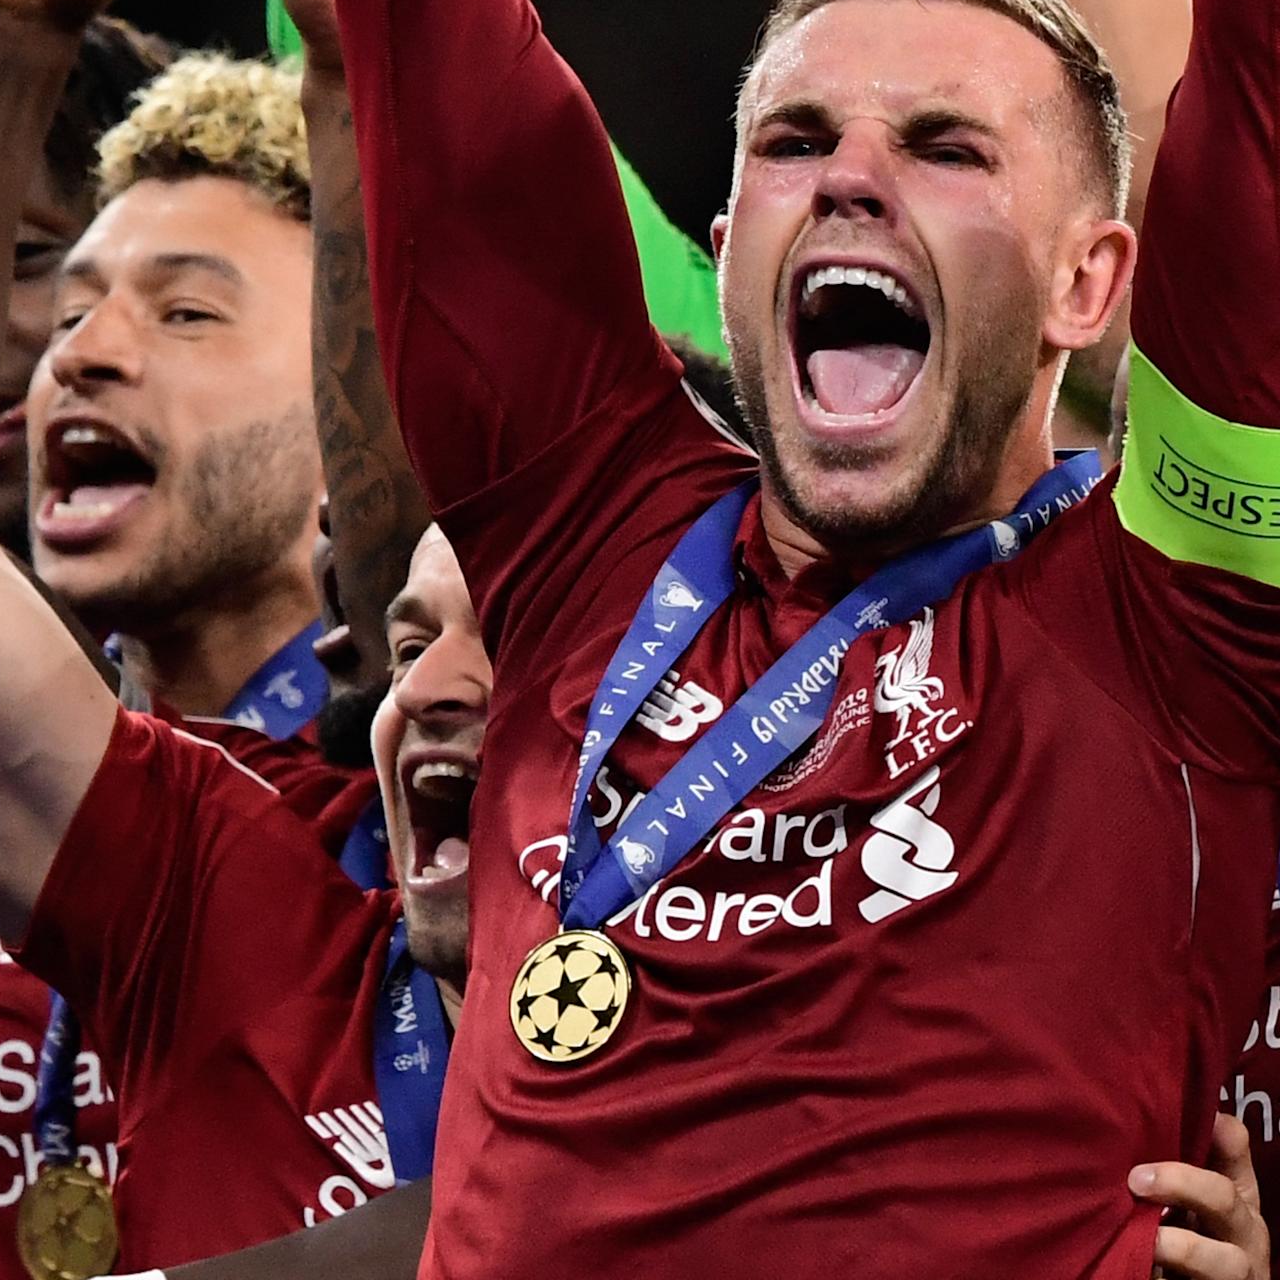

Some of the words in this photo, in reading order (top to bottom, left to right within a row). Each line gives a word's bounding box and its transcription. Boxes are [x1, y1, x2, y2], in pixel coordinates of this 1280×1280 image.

[599, 619, 677, 717] FINAL
[751, 716, 778, 744] 19
[884, 707, 974, 780] L.F.C.
[584, 765, 849, 864] Sard
[646, 740, 749, 837] FINAL
